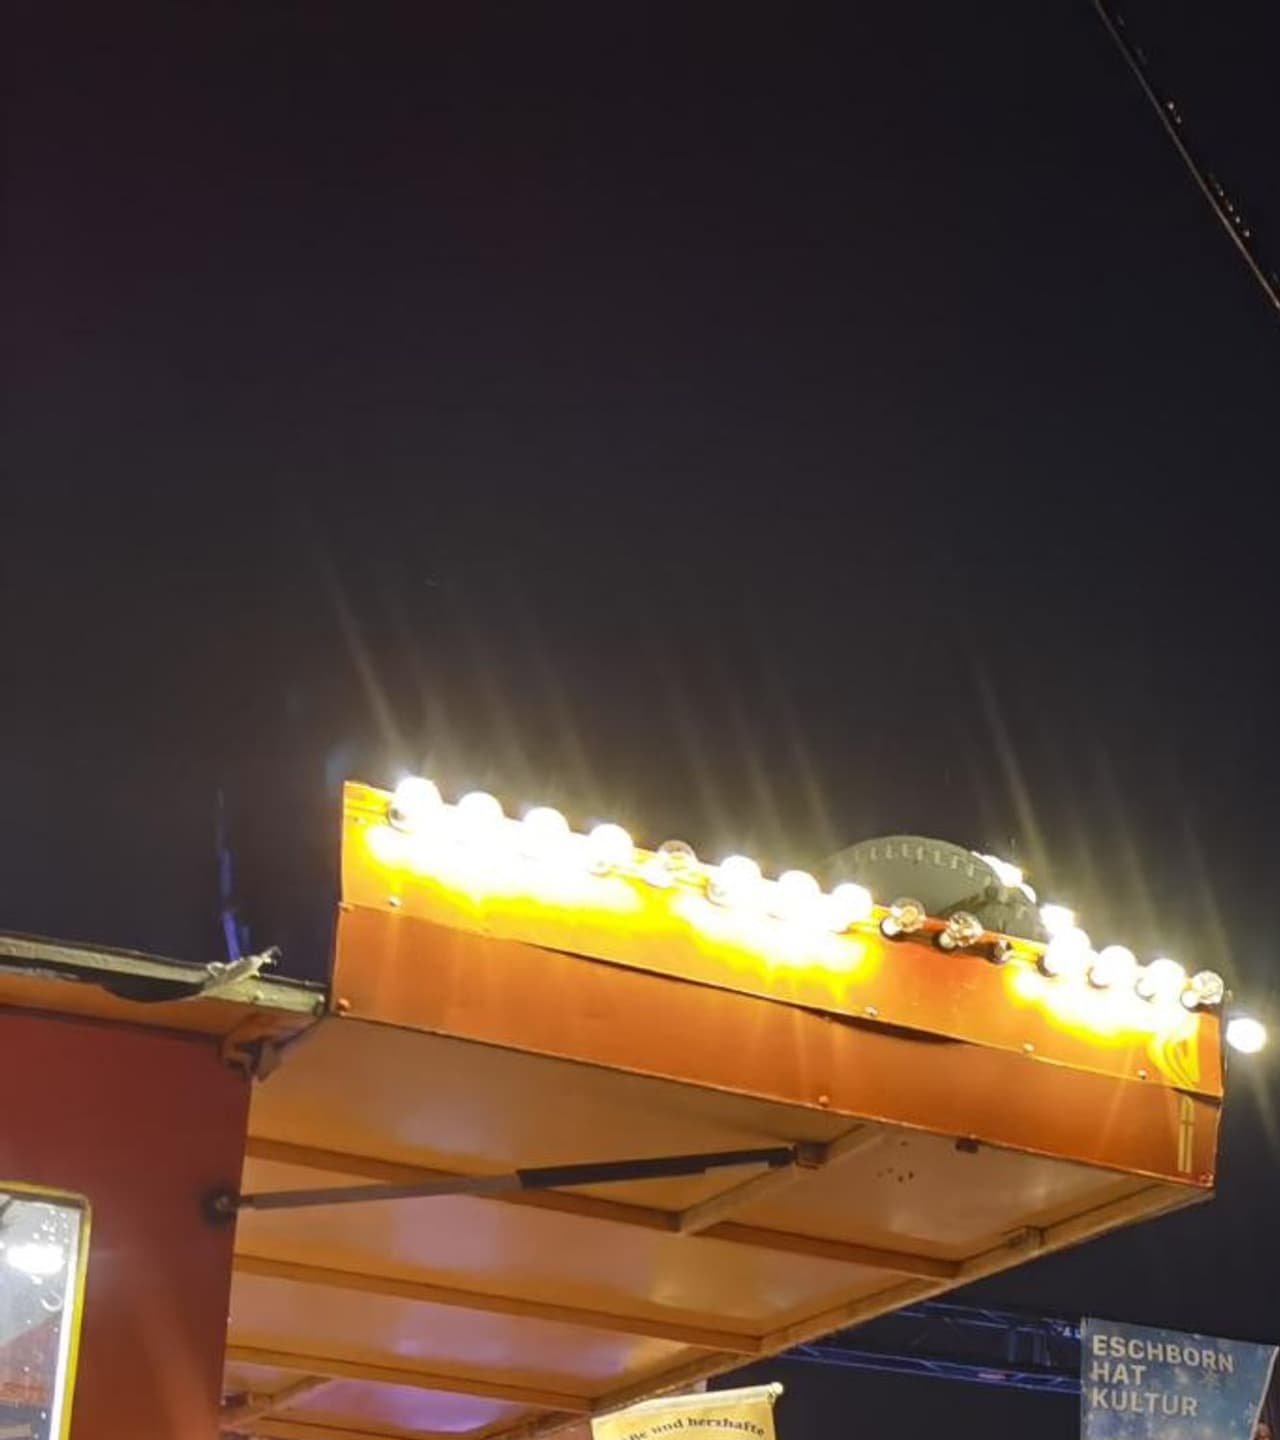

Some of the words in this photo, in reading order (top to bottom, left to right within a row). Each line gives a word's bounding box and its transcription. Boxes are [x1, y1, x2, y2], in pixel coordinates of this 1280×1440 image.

[1092, 1334, 1234, 1373] ESCHBORN
[1091, 1360, 1147, 1385] HAT
[1091, 1387, 1198, 1417] KULTUR
[651, 1418, 684, 1436] und
[687, 1416, 766, 1438] herzhafte
